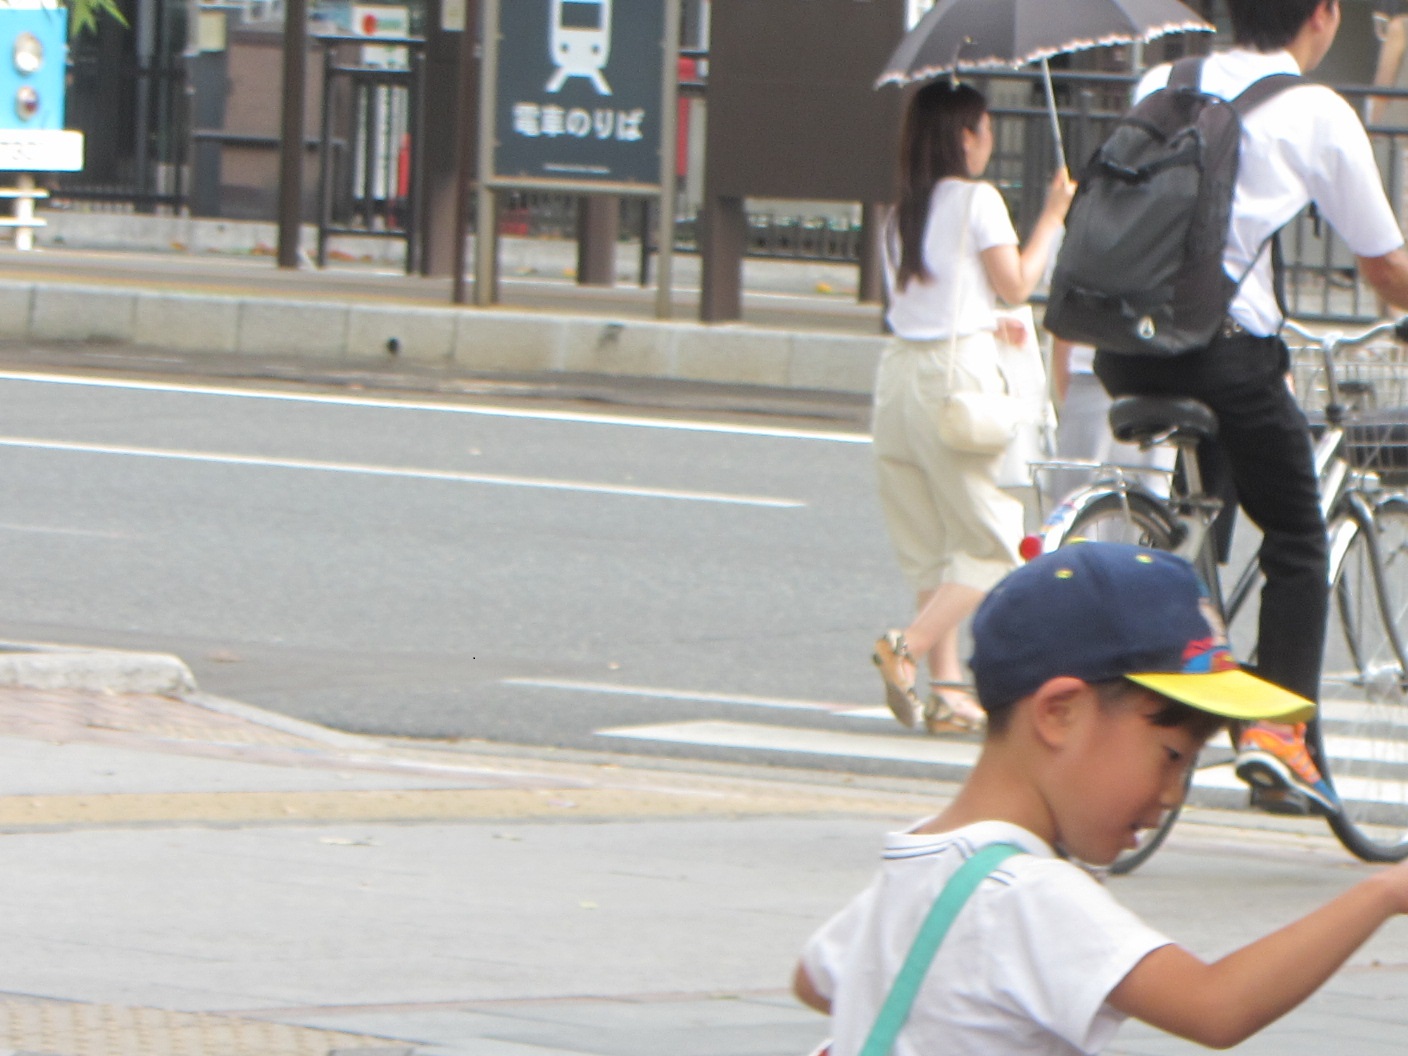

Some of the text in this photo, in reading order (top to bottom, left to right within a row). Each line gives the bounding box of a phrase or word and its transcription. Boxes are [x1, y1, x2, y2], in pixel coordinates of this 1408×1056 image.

[513, 103, 645, 141] 電車のりば
